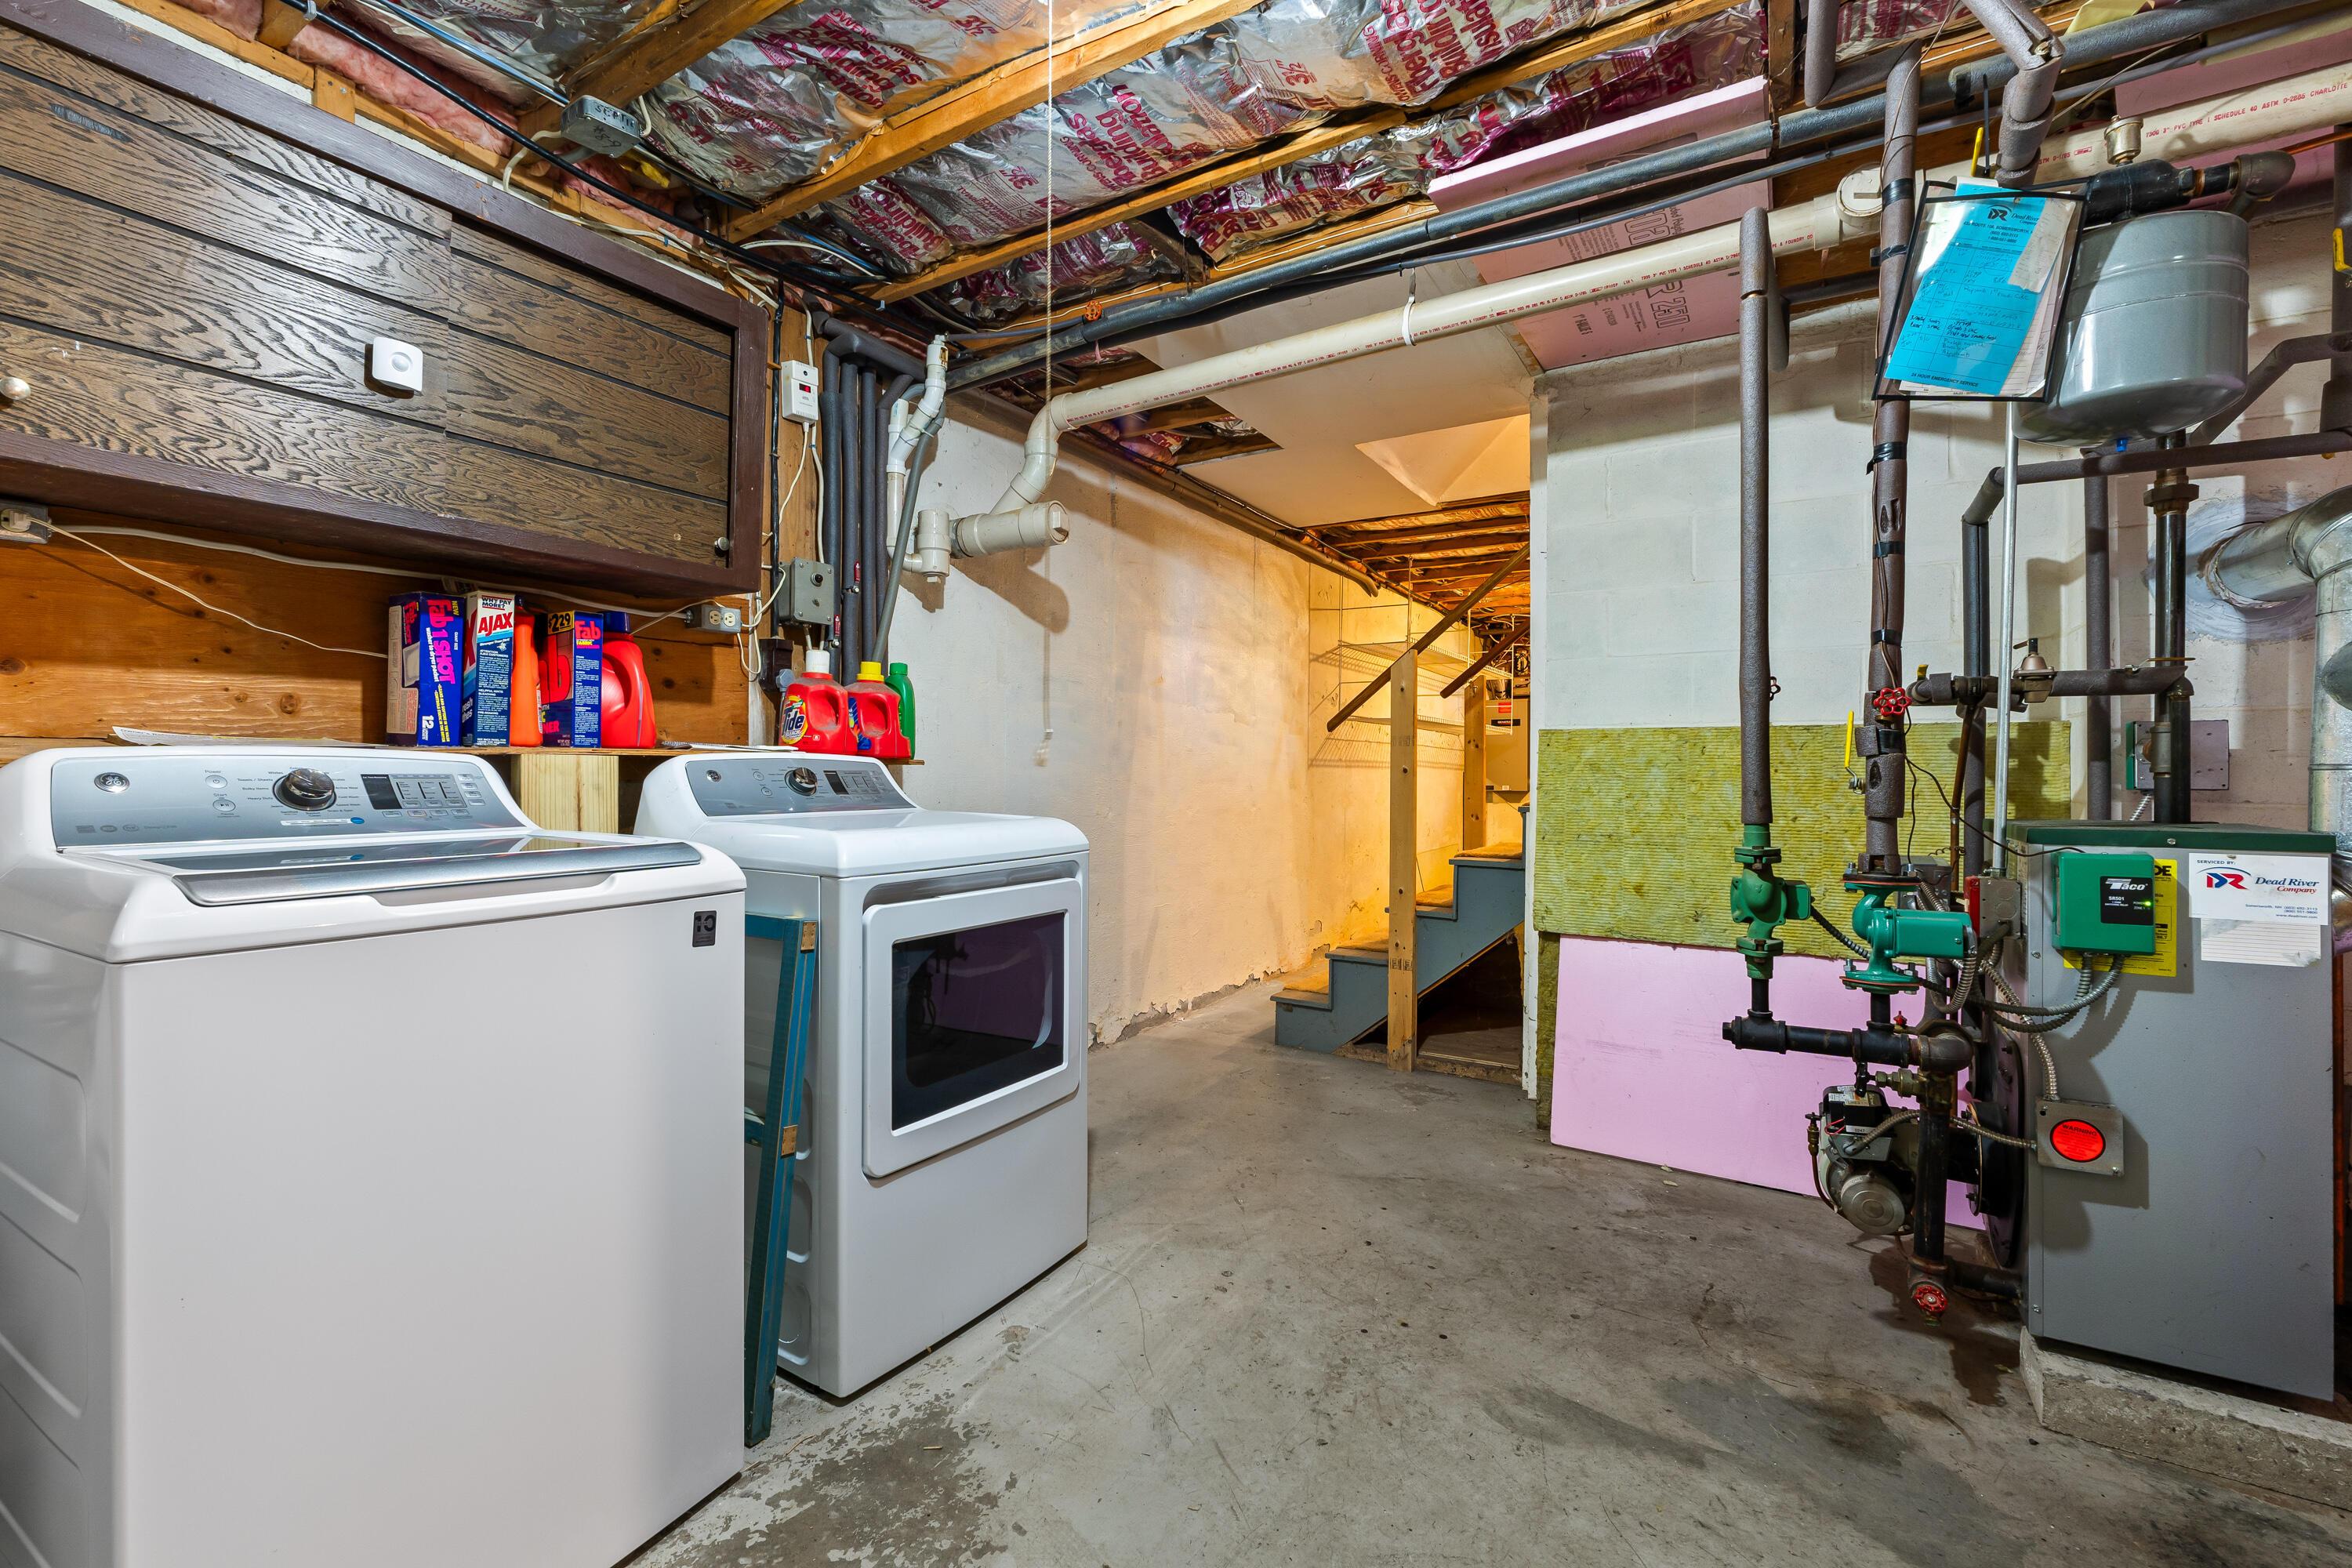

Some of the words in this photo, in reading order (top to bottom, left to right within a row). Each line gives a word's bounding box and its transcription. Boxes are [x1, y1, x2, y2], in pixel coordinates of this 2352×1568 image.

[2213, 107, 2247, 122] SCHEDULE
[2310, 82, 2349, 98] CHARLOTTE
[1095, 108, 1169, 180] Building
[1931, 376, 1960, 384] EMERGENCY
[427, 599, 454, 628] Fab
[477, 611, 514, 637] AJAX
[574, 620, 602, 641] Fab
[434, 639, 456, 684] SHOT
[422, 714, 434, 729] 12
[783, 706, 806, 735] Tide
[2105, 877, 2147, 891] Taco
[2254, 877, 2287, 886] Dead
[2288, 878, 2320, 887] River
[2277, 885, 2318, 895] Company
[2062, 1123, 2098, 1137] WARNING
